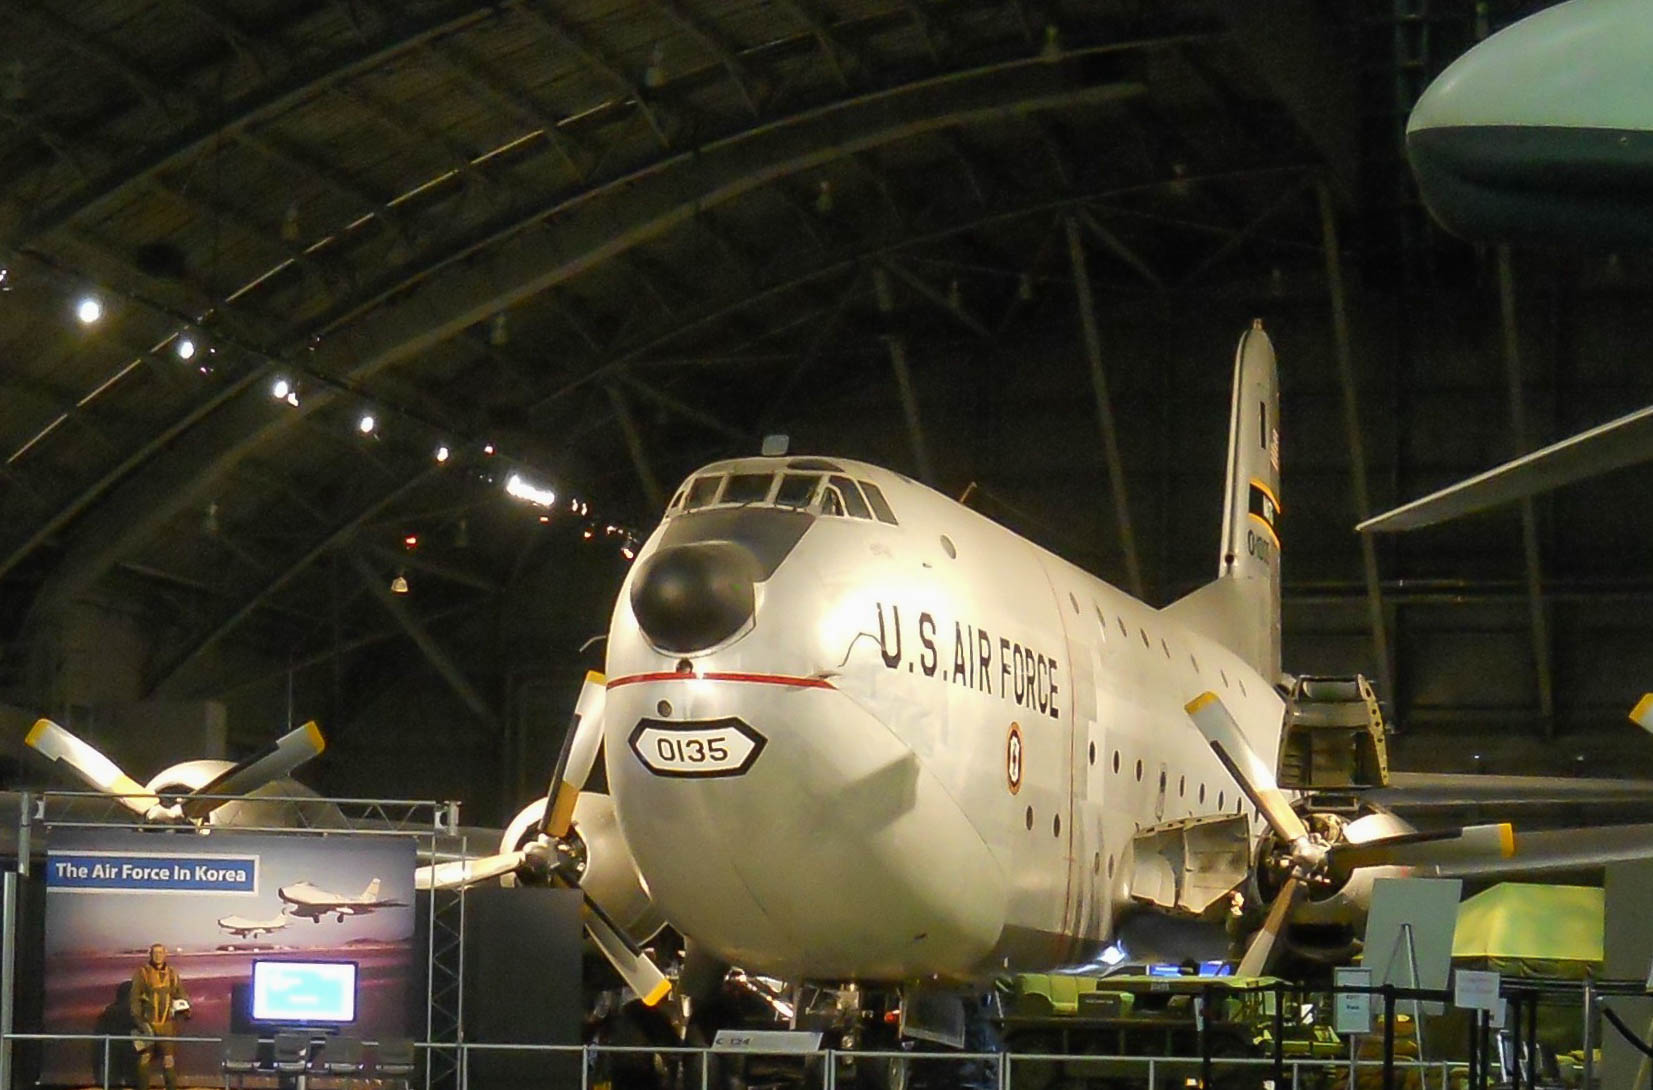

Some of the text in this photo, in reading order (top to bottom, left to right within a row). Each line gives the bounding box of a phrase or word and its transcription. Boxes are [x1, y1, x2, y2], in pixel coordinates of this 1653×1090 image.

[1000, 636, 1059, 719] FORCE
[657, 737, 729, 763] 0135
[56, 862, 246, 882] The Air Force In Korea
